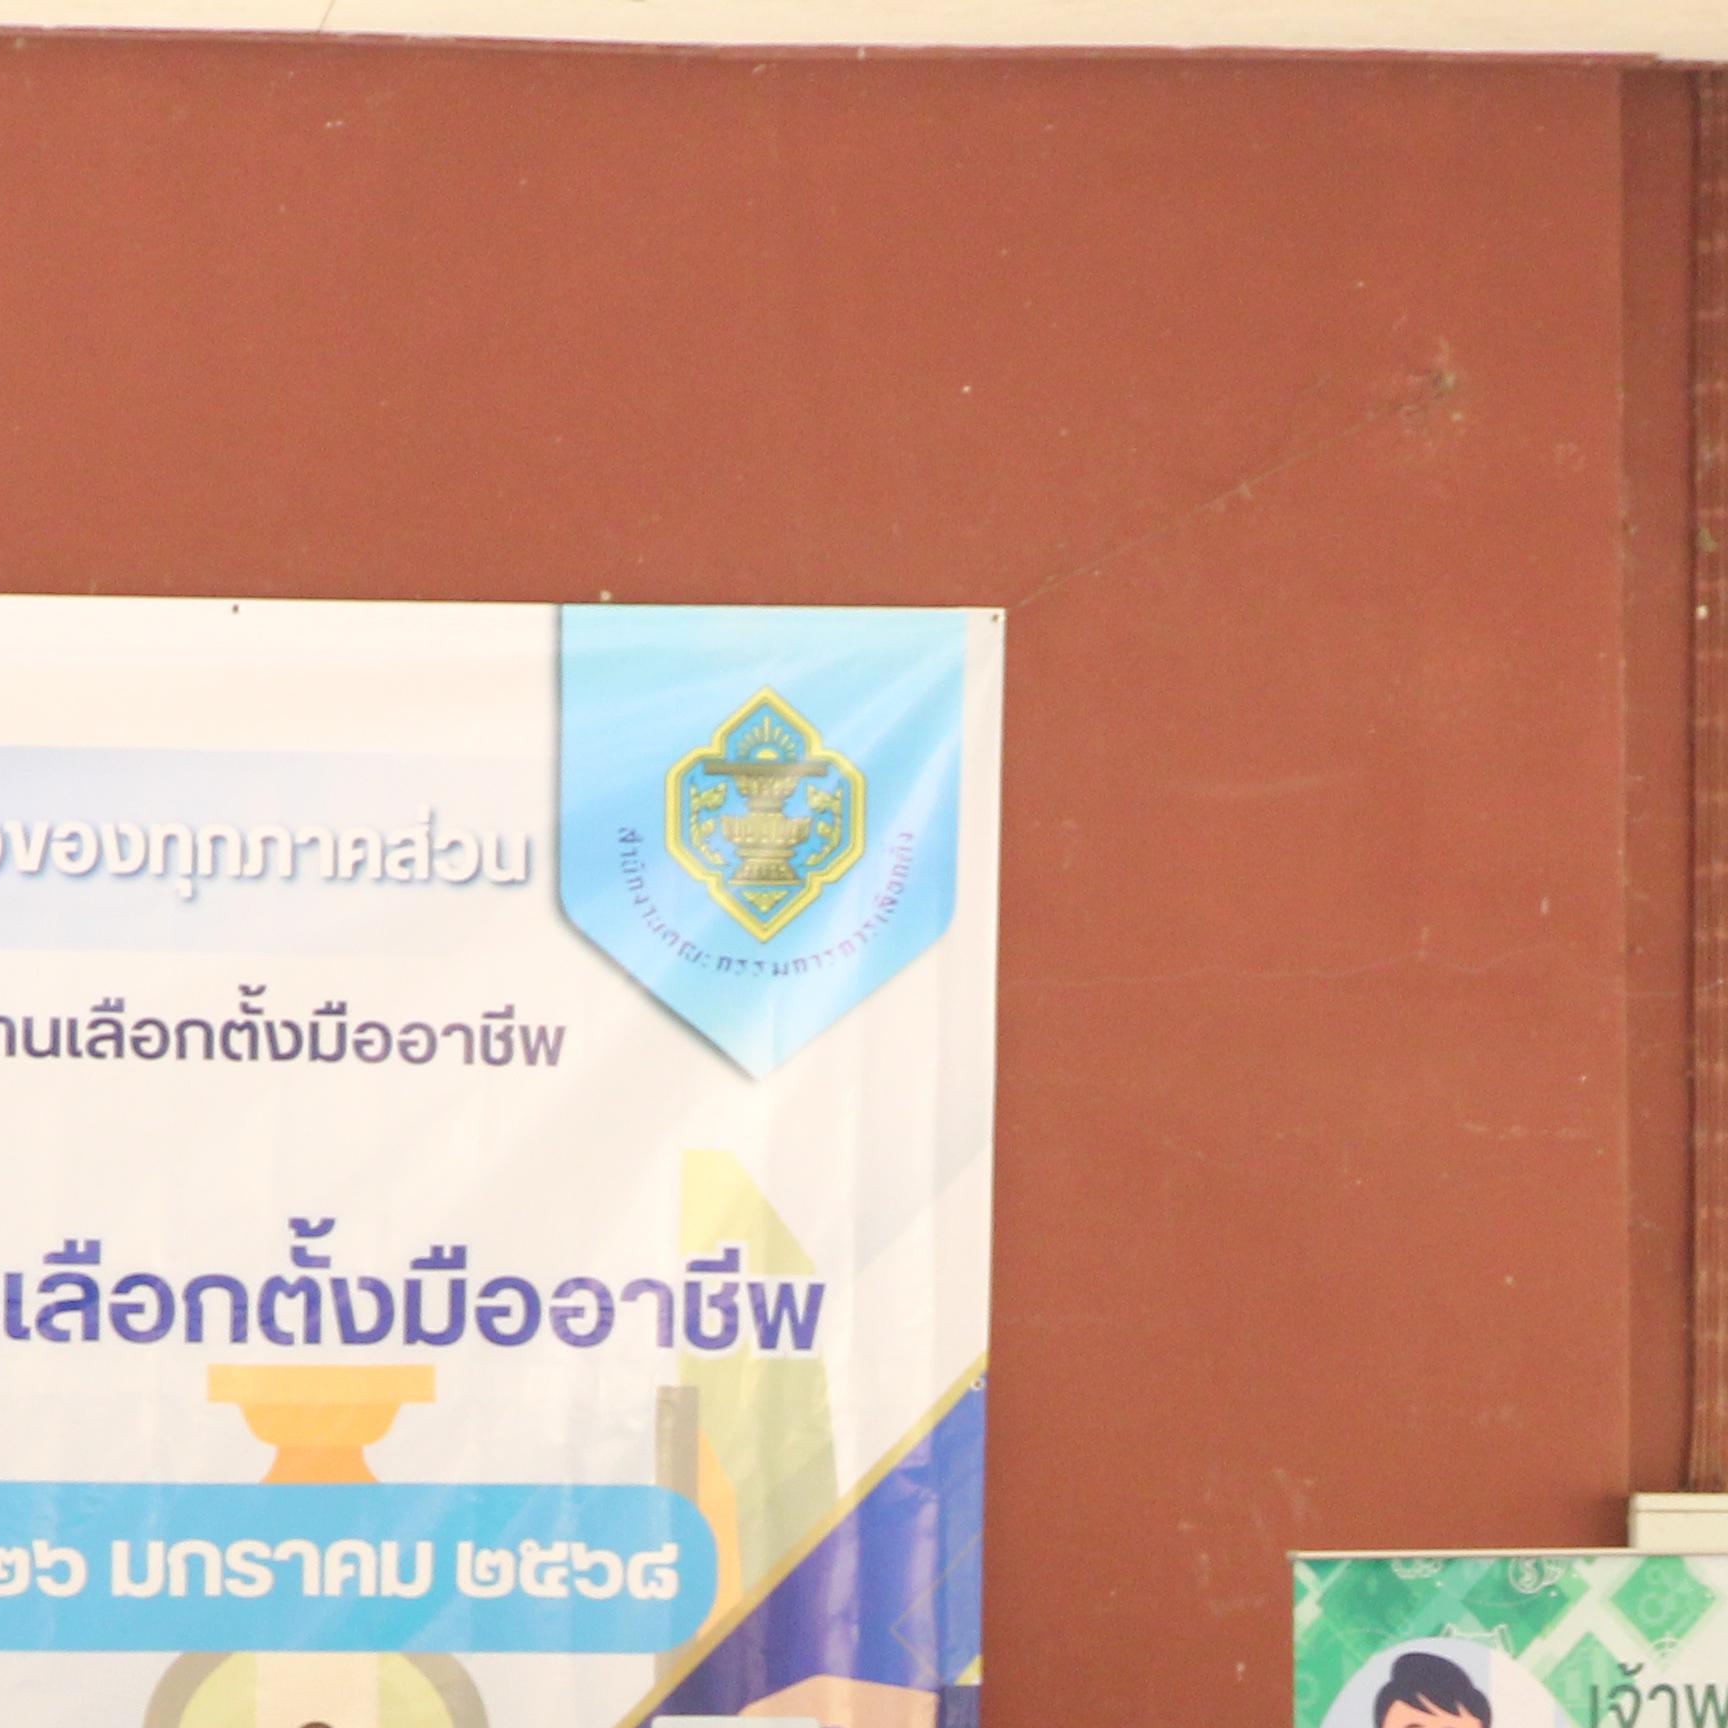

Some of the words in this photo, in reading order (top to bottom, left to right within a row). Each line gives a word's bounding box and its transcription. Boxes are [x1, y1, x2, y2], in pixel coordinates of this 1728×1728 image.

[111, 1537, 432, 1599] มกราคม
[456, 1538, 678, 1601] ๒๕๖๘
